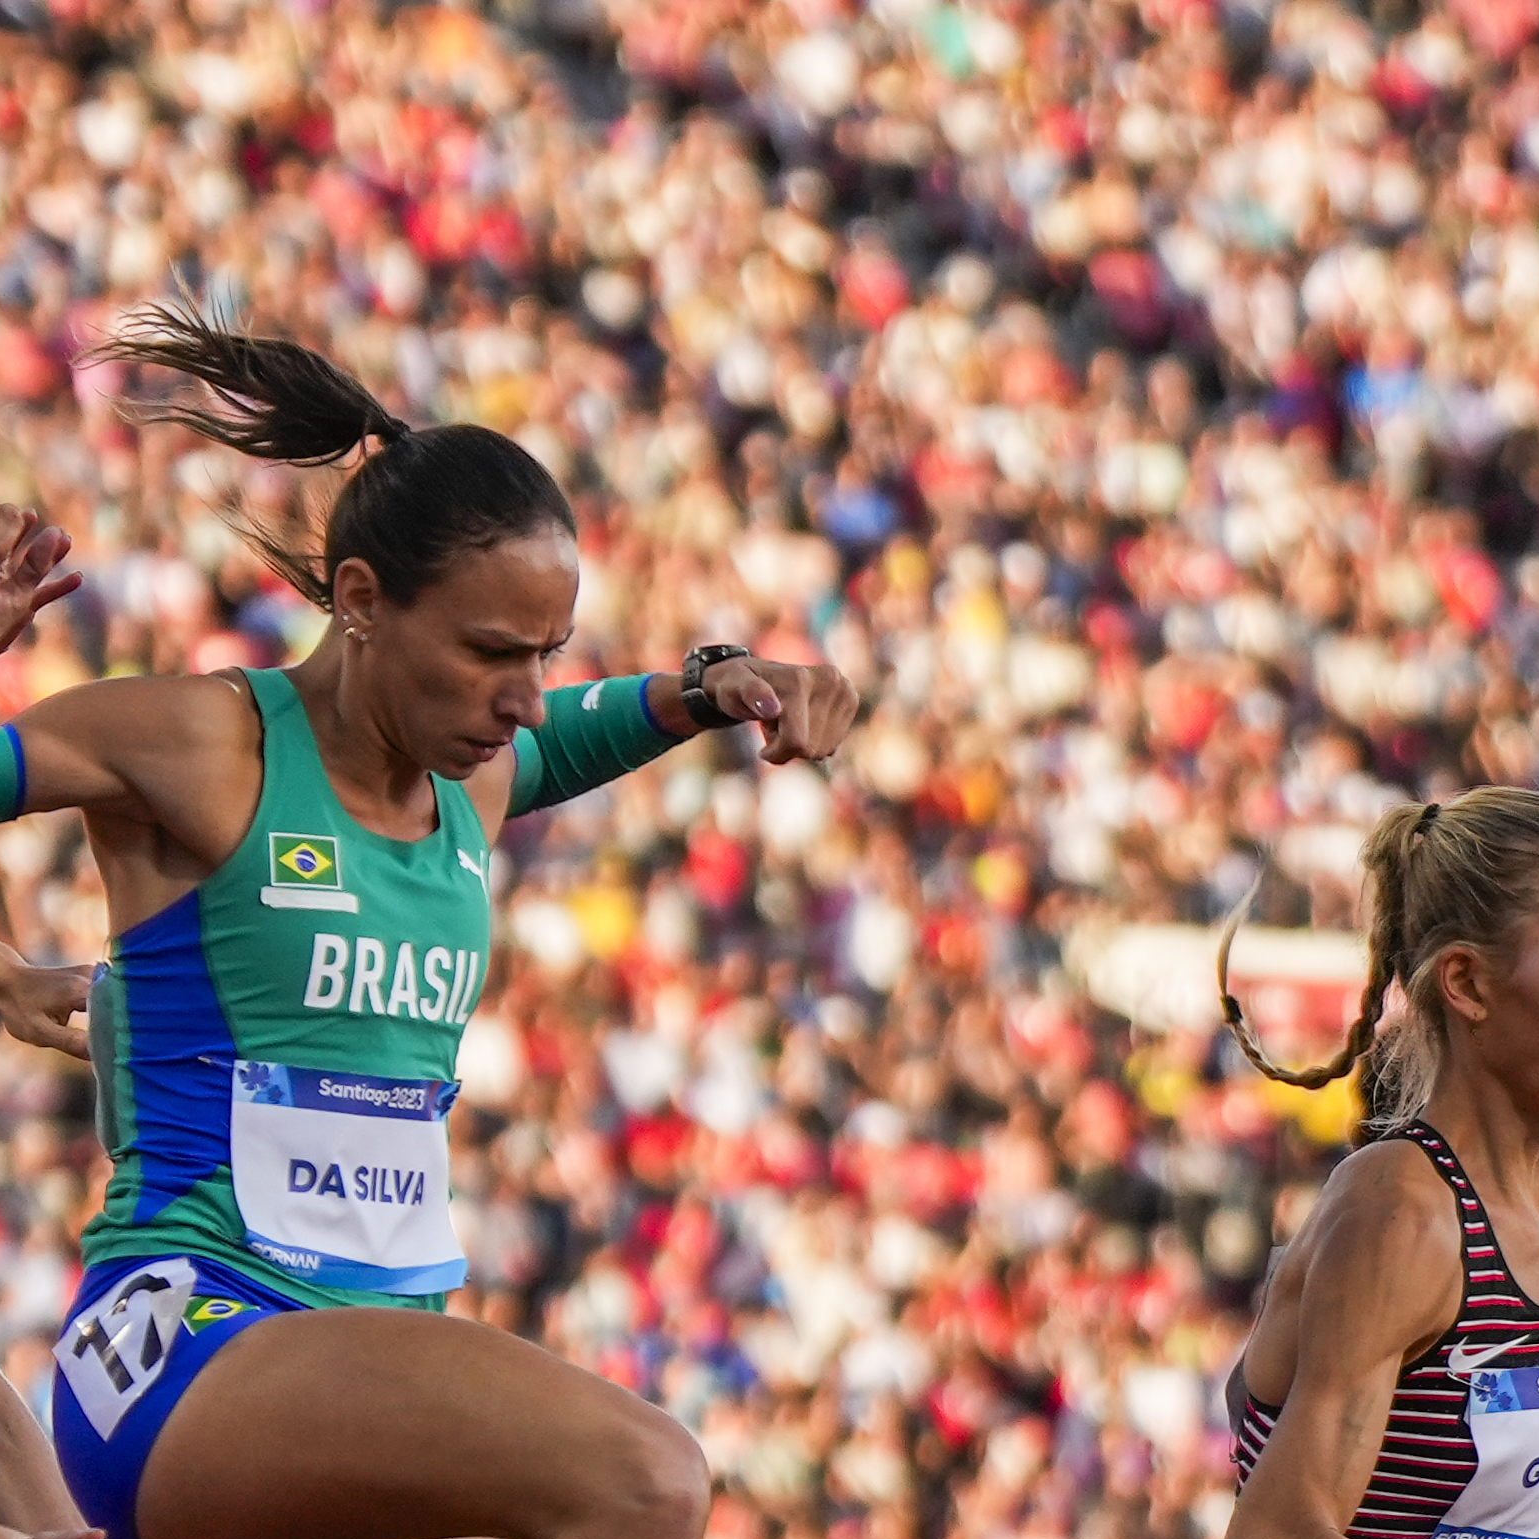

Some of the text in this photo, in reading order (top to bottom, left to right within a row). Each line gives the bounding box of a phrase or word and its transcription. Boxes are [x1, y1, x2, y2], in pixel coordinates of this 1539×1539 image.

[303, 933, 478, 1024] BRASIL
[287, 1158, 425, 1206] DA SILVA
